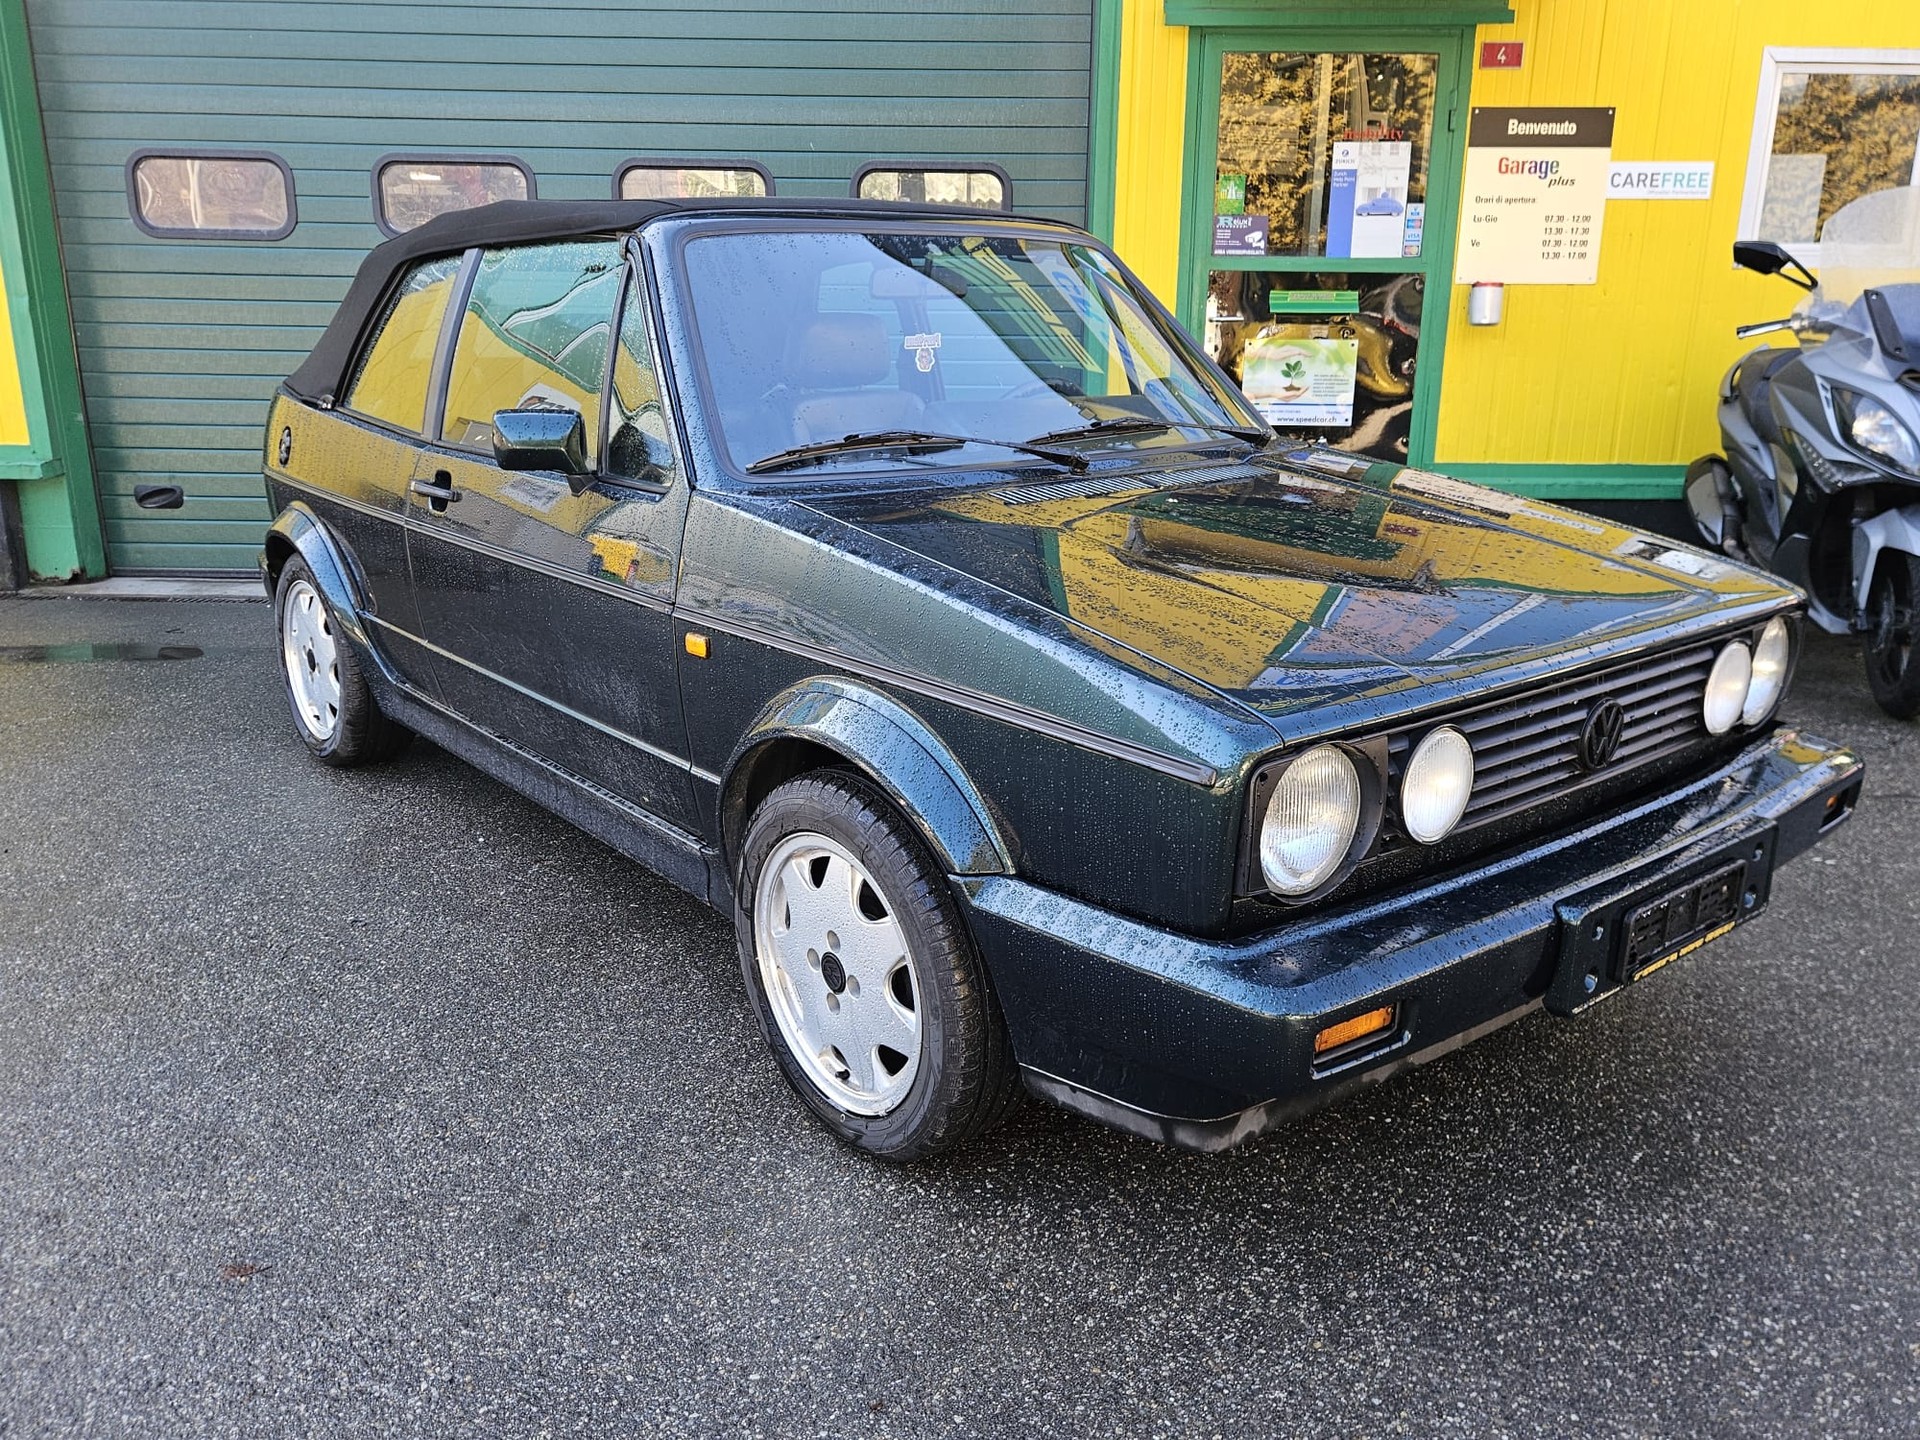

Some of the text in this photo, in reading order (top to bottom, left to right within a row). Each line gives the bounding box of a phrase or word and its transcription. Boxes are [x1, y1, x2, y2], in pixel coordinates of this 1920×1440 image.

[1496, 46, 1506, 64] 4
[1507, 118, 1577, 135] Benvenuto
[1498, 157, 1560, 180] Garage
[1548, 176, 1576, 188] plus
[1610, 172, 1710, 189] CAREFREE
[1475, 195, 1536, 206] Orari di apertura
[1470, 239, 1481, 247] Ve
